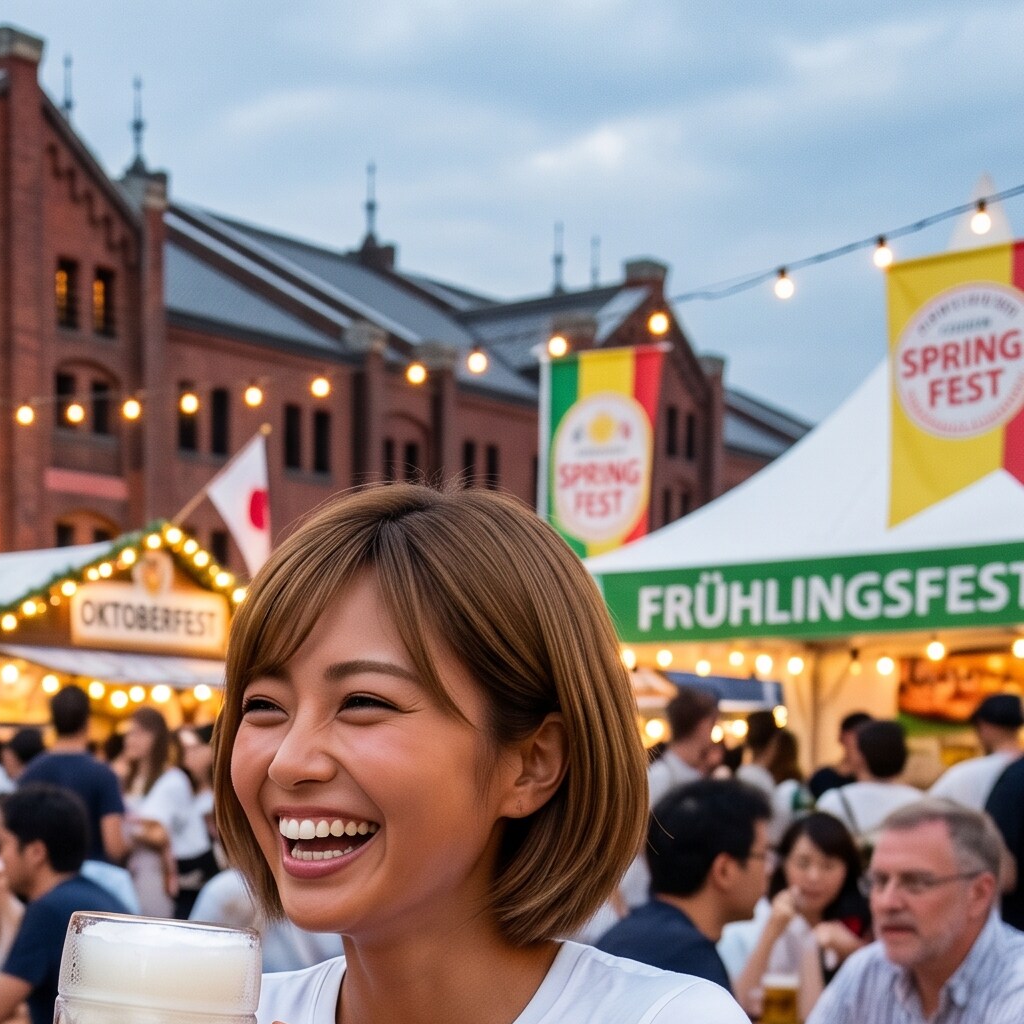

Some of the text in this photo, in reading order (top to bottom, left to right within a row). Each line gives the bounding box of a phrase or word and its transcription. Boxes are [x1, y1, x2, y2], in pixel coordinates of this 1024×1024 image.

[902, 329, 1022, 379] SPRING
[929, 368, 1004, 408] FEST
[559, 459, 640, 489] SPRING
[574, 490, 623, 519] FEST
[638, 561, 1024, 633] FRÜHLINGSFEST
[81, 600, 216, 637] OKTOBERFEST
